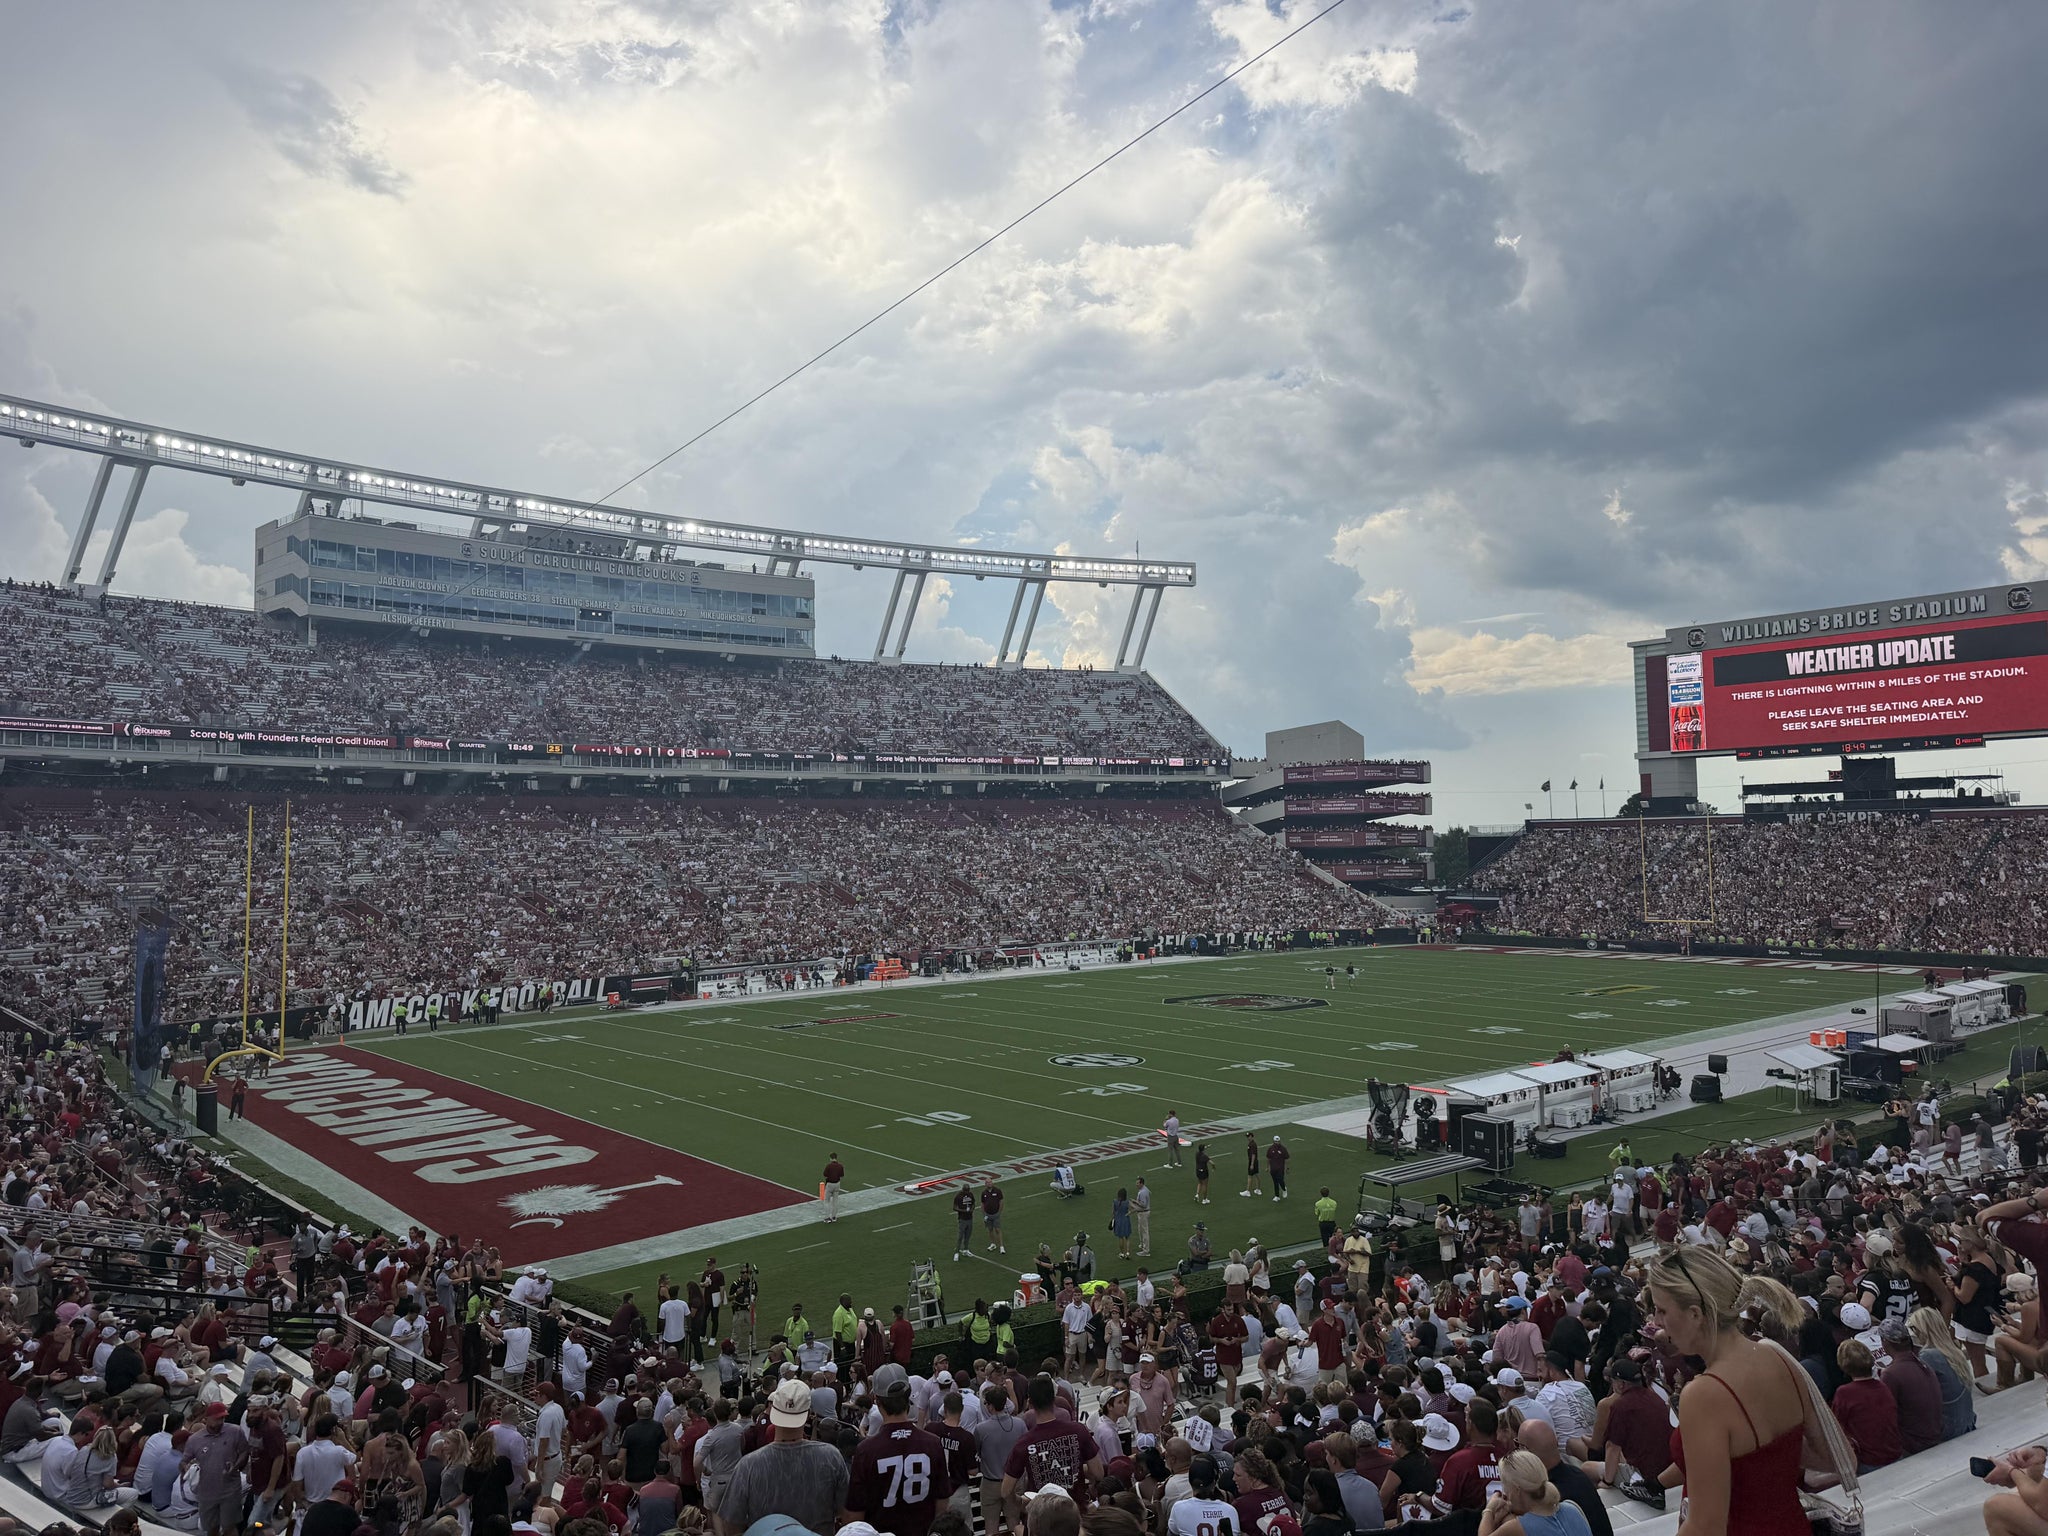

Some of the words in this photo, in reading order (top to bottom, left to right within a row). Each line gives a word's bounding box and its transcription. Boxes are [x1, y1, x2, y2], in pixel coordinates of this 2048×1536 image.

[480, 546, 525, 564] SOUTH
[533, 553, 601, 572] CAROLINA
[608, 563, 686, 581] GAMECOCKS
[378, 575, 415, 589] JADEVEON
[417, 581, 450, 593] CLOWNEY
[455, 585, 459, 593] 7
[471, 587, 499, 598] GEORGE
[500, 590, 527, 601] ROGERS
[531, 593, 540, 603] 38
[551, 596, 583, 607] STERLING
[585, 599, 610, 610] SHARPE
[631, 604, 650, 614] STEVE
[679, 608, 687, 617] 37
[700, 611, 715, 620] MIKE
[716, 613, 745, 623] JOHNSON
[1721, 608, 1879, 641] WILLIAMS-BRICE
[1889, 595, 1986, 622] STADIUM
[382, 613, 411, 625] ALSHON
[414, 617, 446, 629] JEFFERY
[1786, 643, 1874, 675] WEATHER
[1878, 635, 1956, 667] UPDATE
[1731, 691, 1763, 701] THERE
[1765, 690, 1774, 698] IS
[1777, 683, 1833, 696] LIGHTNING
[1836, 681, 1876, 691] WITHIN
[1878, 680, 1885, 688] 8
[1888, 676, 1921, 686] MILES
[1924, 674, 1940, 684] OF
[1943, 672, 1966, 682] THE
[1970, 667, 2028, 679] STADIUM.
[1768, 709, 1806, 720] PLEASE
[1809, 706, 1843, 716] LEAVE
[1846, 705, 1867, 714] THE
[1870, 700, 1918, 712] SEATING
[1921, 698, 1954, 708] AREA
[1957, 695, 1983, 705] AND
[1782, 721, 1808, 731] SEEK
[1809, 719, 1838, 729] SAFE
[1840, 715, 1887, 727] SHELTER
[1890, 710, 1969, 724] IMMEDIATELY.
[190, 729, 217, 739] Score
[219, 730, 234, 741] big
[237, 732, 256, 741] with
[258, 732, 298, 743] Founders
[301, 735, 333, 744] Federal
[335, 736, 361, 745] Credit
[363, 738, 388, 747] Union!
[508, 743, 534, 751] 18:49
[1842, 743, 1866, 752] 18:49
[894, 755, 904, 763] big
[905, 755, 917, 763] with
[1786, 812, 1812, 825] THE
[1504, 950, 1924, 975] CAROLINA
[490, 977, 608, 1013] FOOBALL
[1077, 1082, 1148, 1096] 20
[218, 1052, 600, 1184] GAMECOCKS
[895, 1110, 972, 1127] 10
[1203, 1363, 1218, 1378] 62
[877, 1453, 931, 1508] 78
